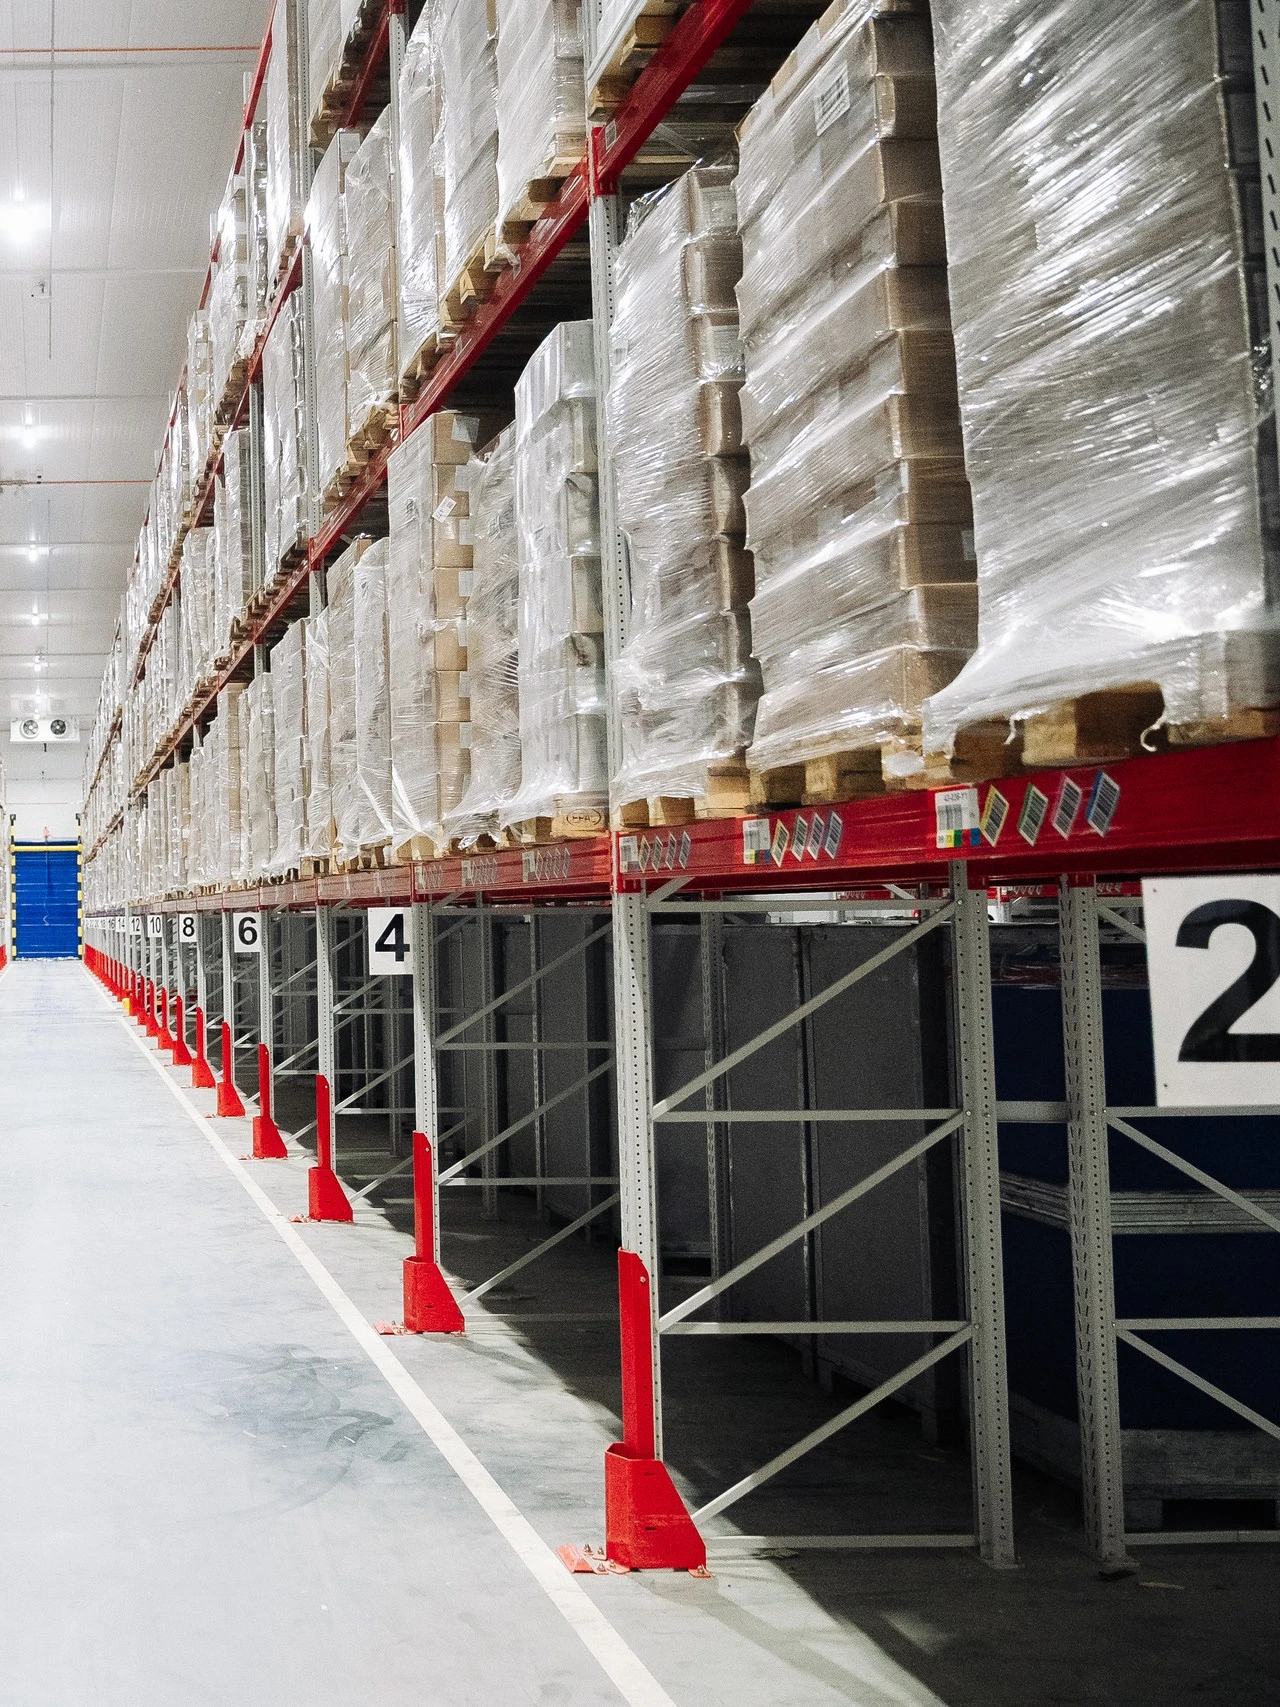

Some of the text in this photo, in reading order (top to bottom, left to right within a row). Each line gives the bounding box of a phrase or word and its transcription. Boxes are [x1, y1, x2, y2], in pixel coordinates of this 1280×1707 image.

[131, 918, 140, 932] 12
[150, 917, 161, 933] 10
[182, 917, 195, 937] 8
[238, 916, 258, 945] 6
[375, 913, 410, 962] 4
[1175, 899, 1280, 1062] 2
